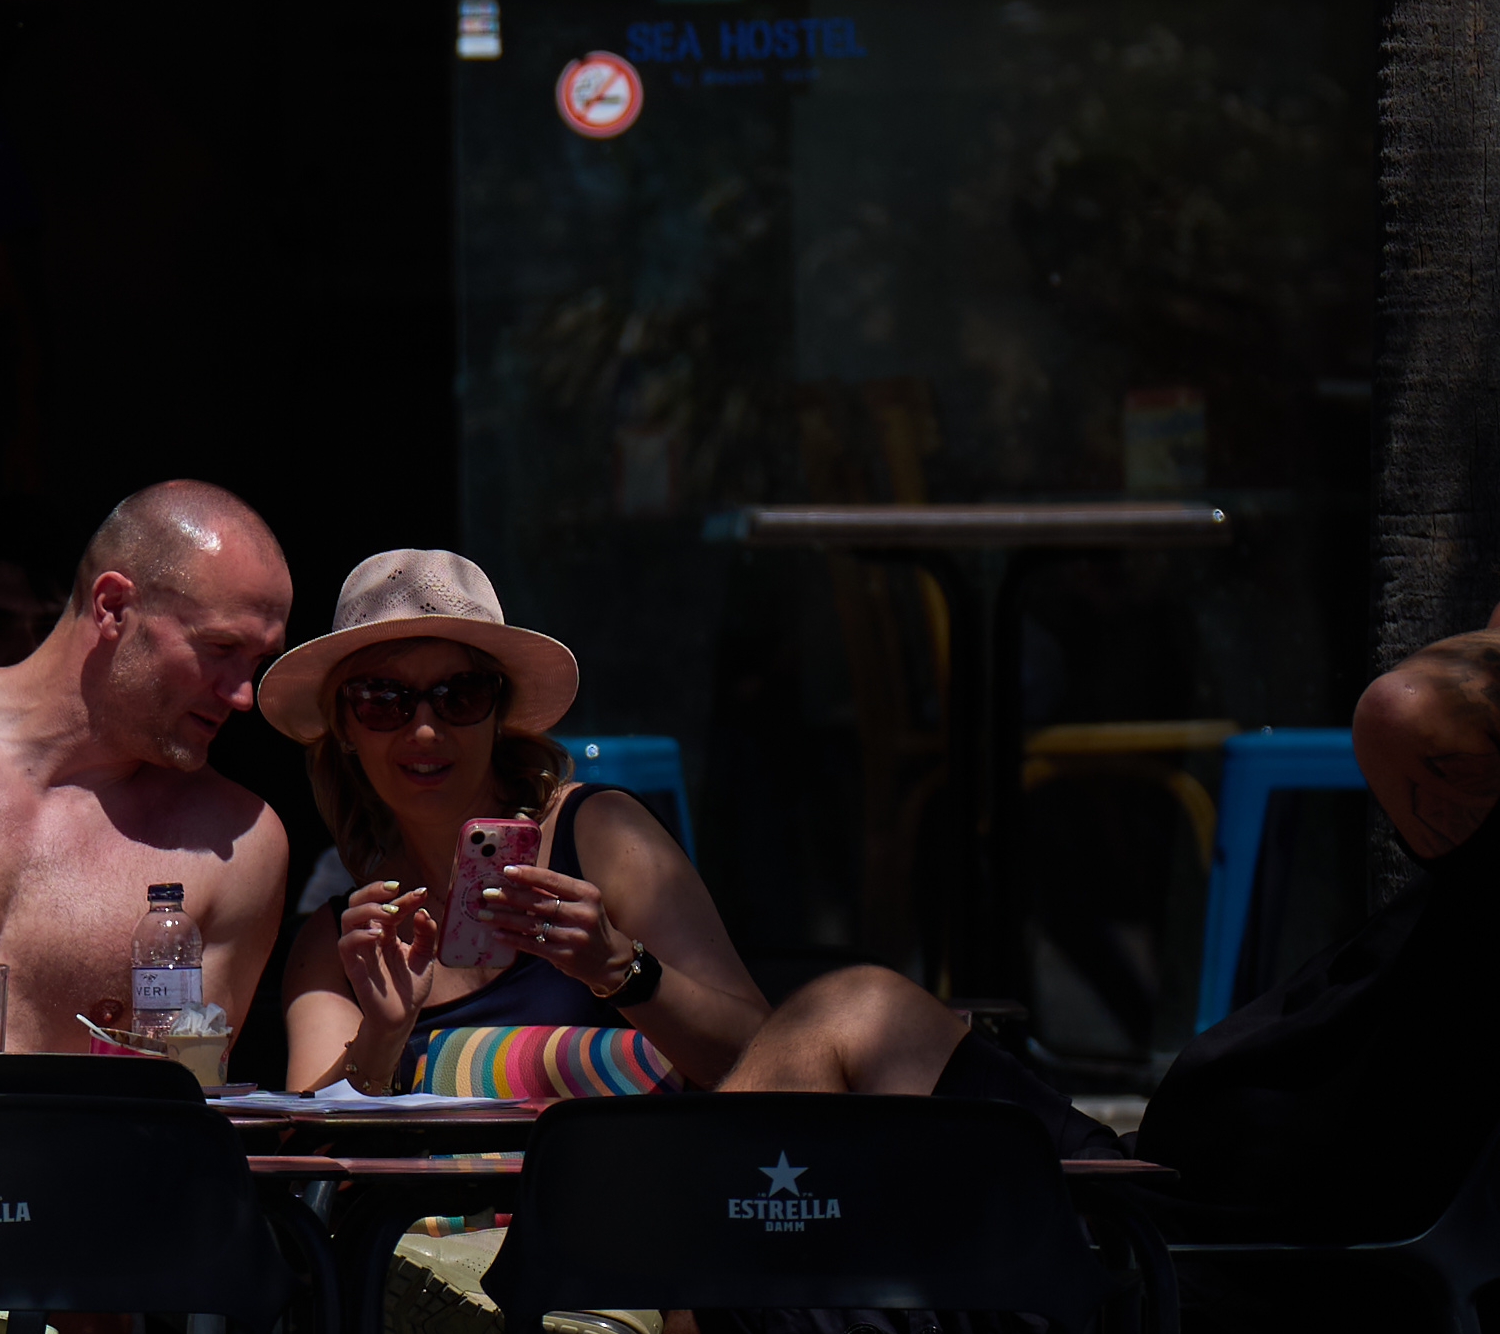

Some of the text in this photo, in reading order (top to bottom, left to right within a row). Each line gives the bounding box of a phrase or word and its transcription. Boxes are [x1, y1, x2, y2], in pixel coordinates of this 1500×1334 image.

[626, 18, 868, 63] SEA HOSTEL
[136, 986, 168, 996] VERI
[728, 1198, 842, 1220] ESTRELLA
[765, 1221, 805, 1232] DAMM
